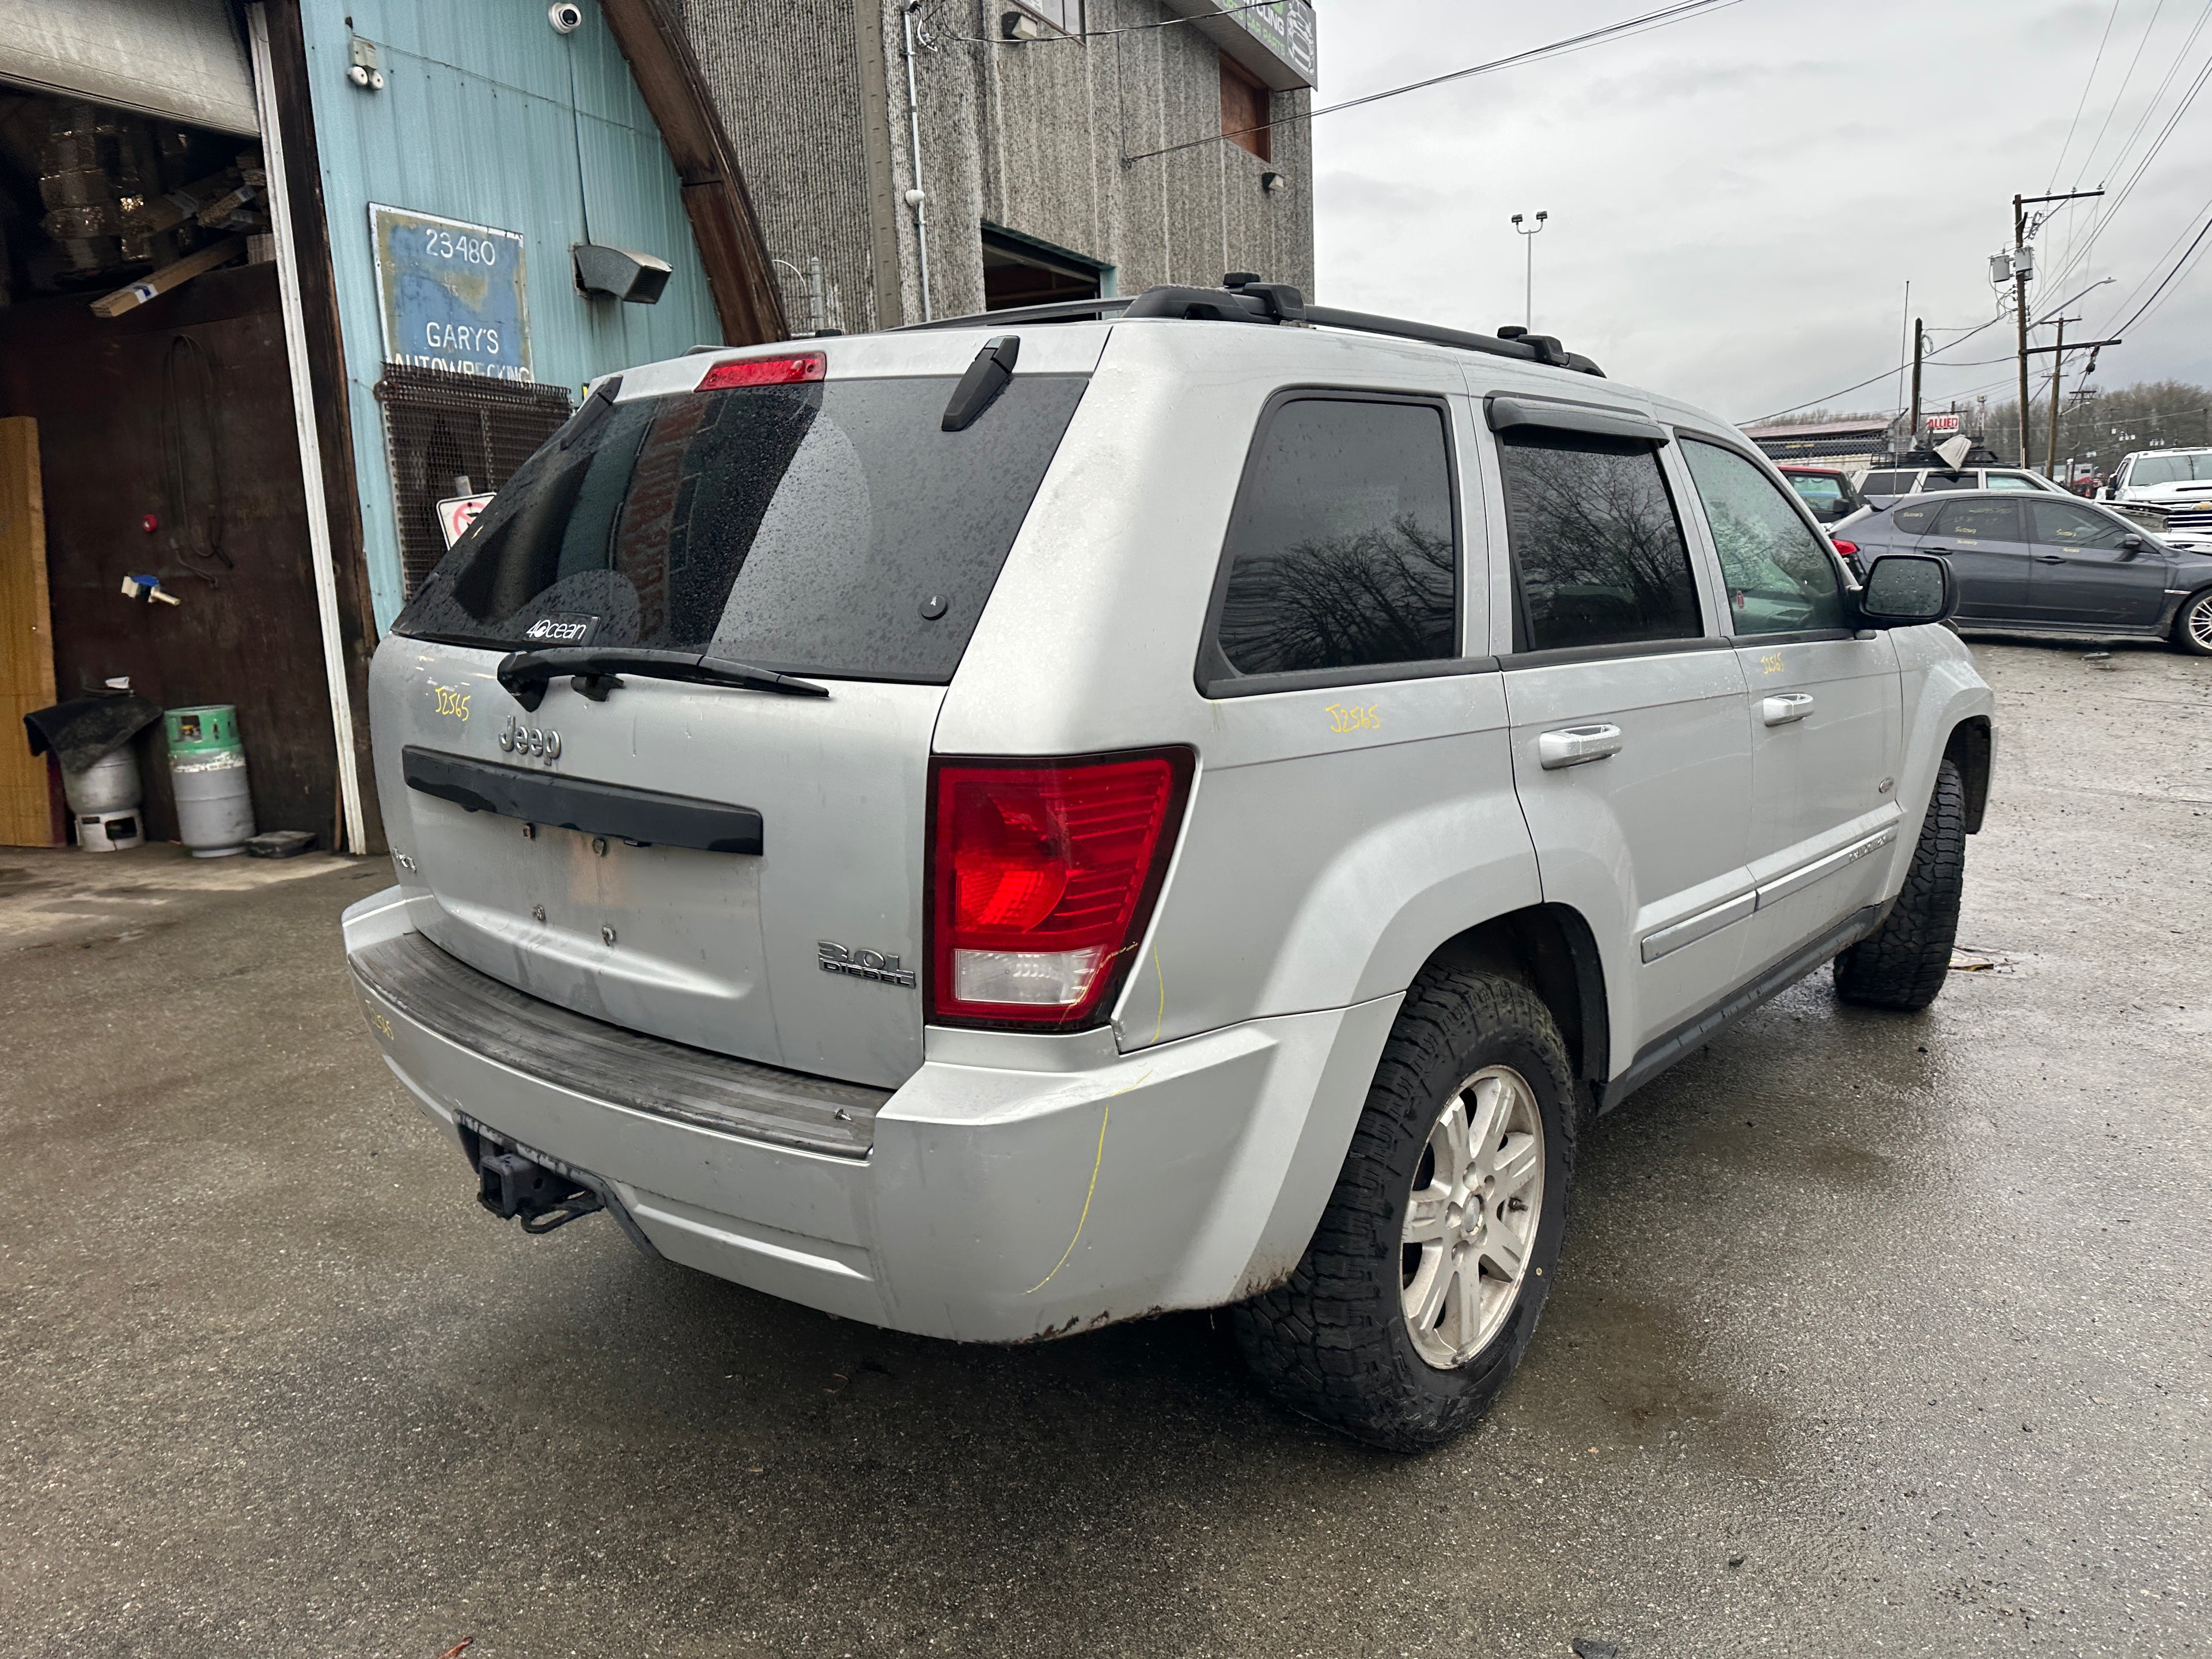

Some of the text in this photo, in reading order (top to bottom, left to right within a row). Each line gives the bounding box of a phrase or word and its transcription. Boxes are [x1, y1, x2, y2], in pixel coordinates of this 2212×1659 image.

[1247, 13, 1262, 36] CAR
[1263, 31, 1286, 56] PARTS
[426, 229, 495, 266] 23480
[426, 321, 499, 354] GARY'S
[1927, 418, 1958, 429] ALLIED
[435, 685, 471, 721] J2565
[1325, 703, 1381, 733] J2565
[498, 715, 561, 766] Jeep
[818, 940, 915, 978] 3.0L
[819, 957, 916, 989] DIESEL
